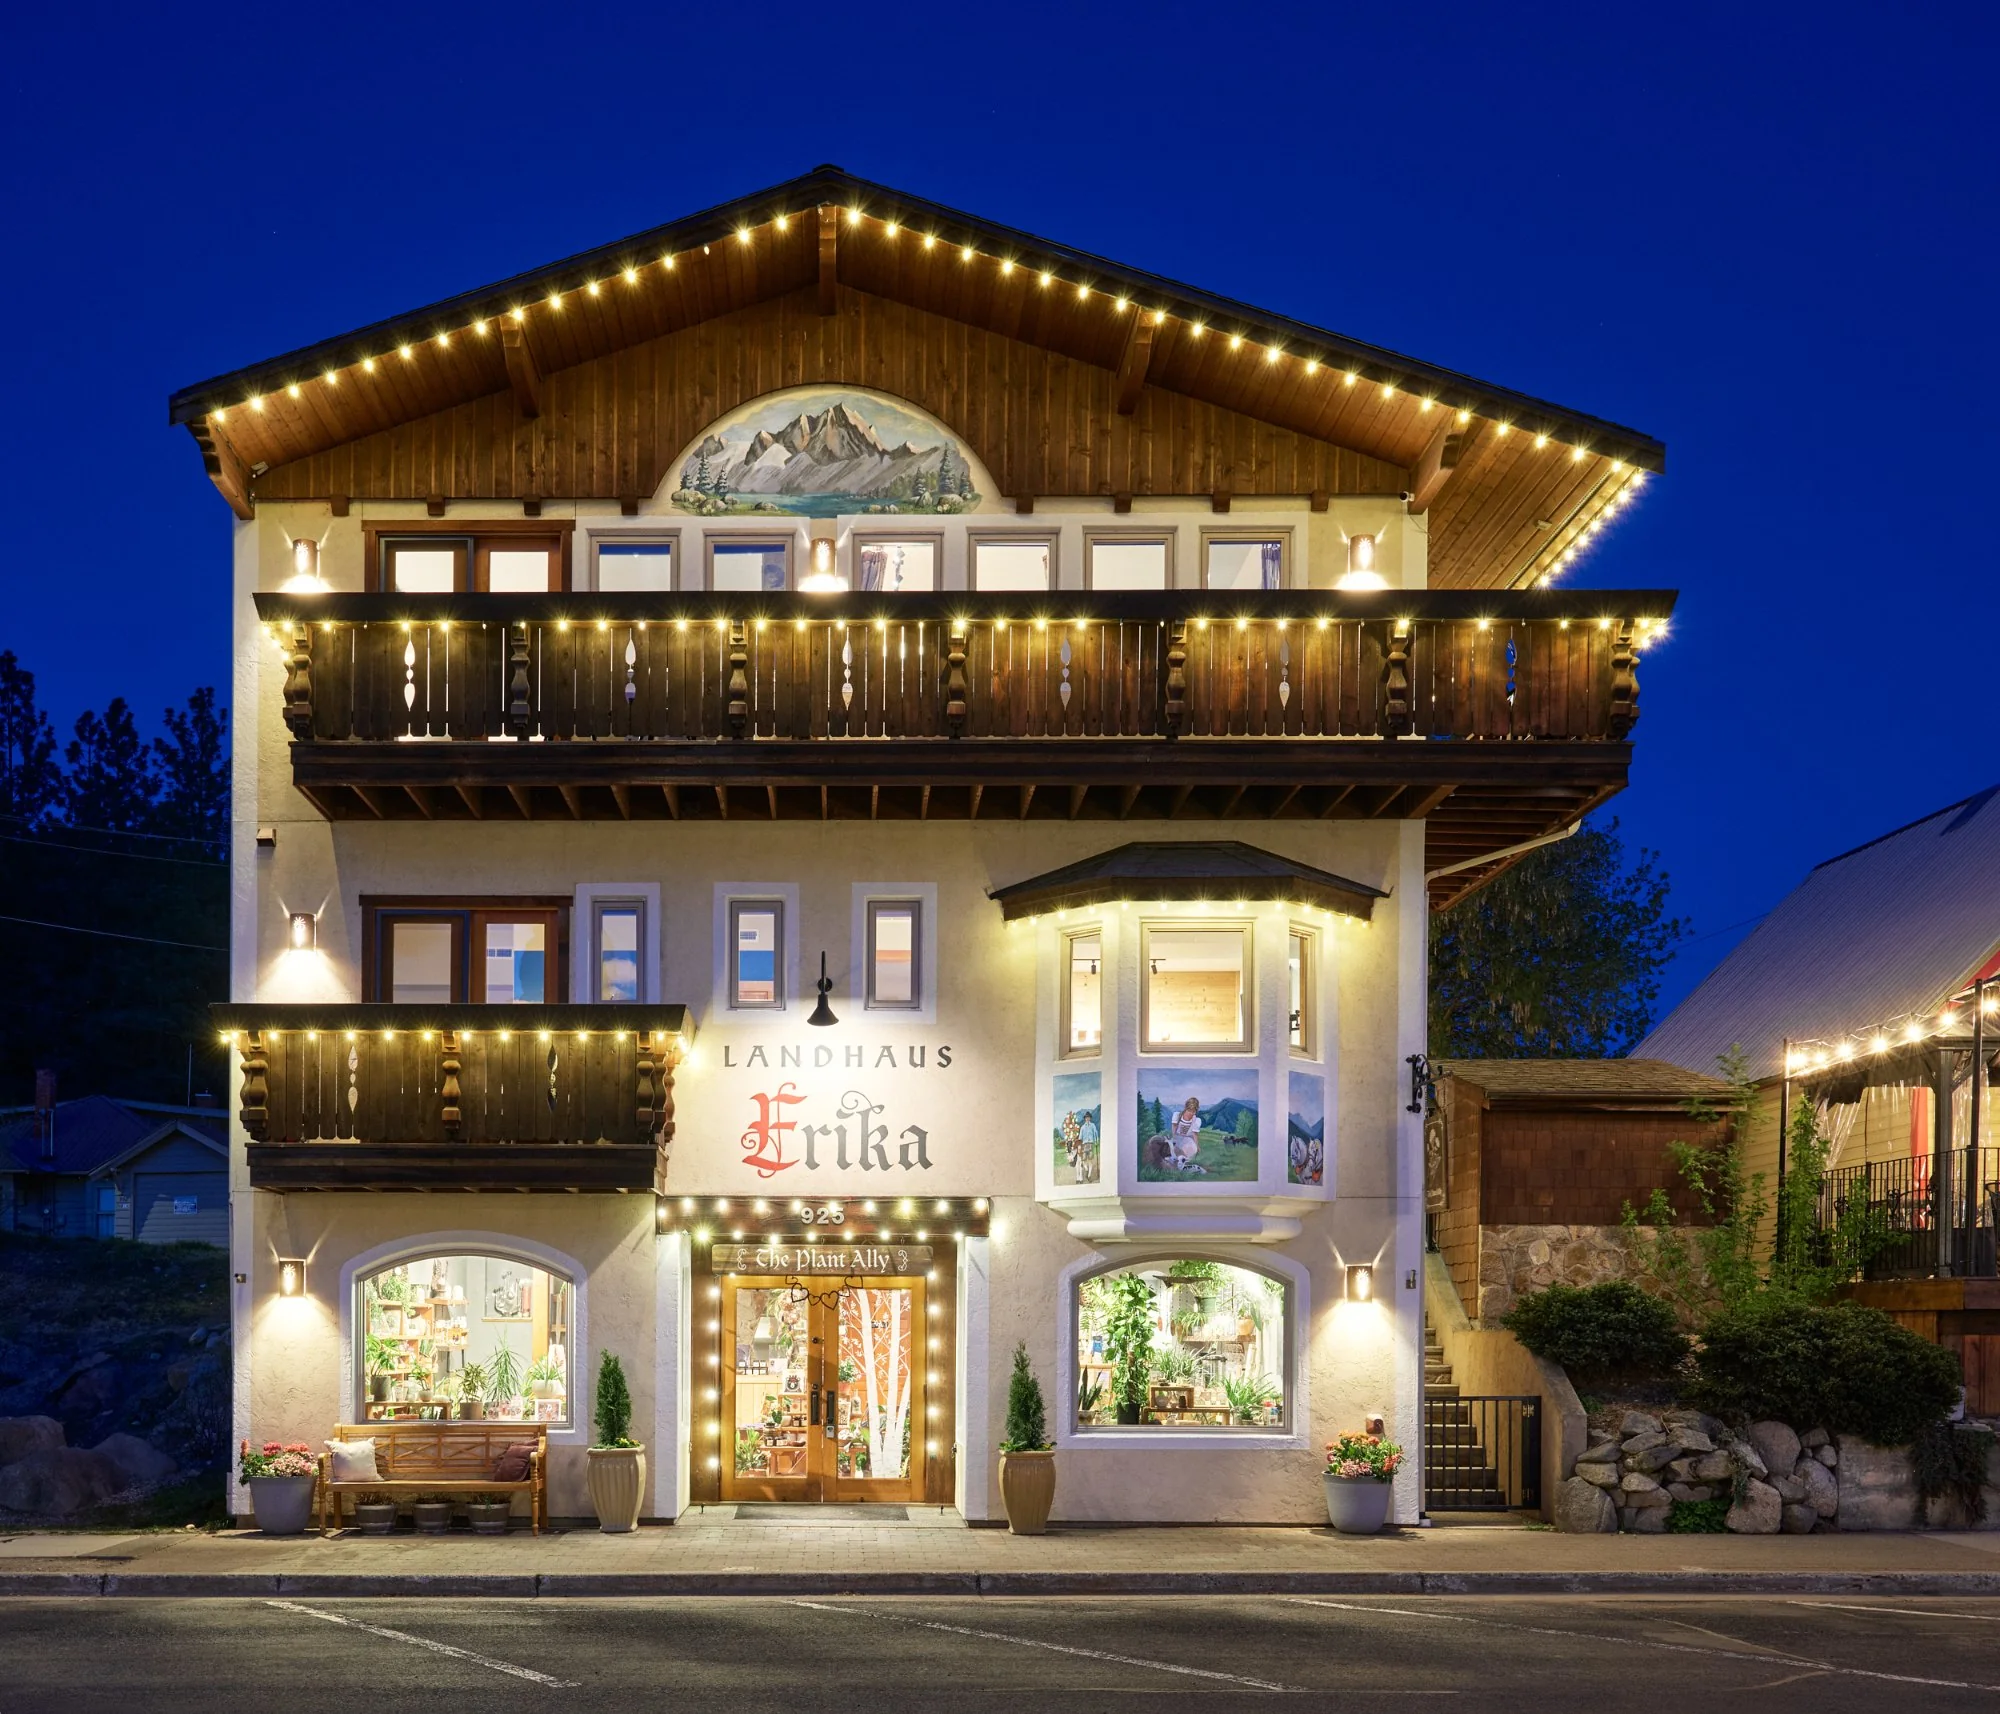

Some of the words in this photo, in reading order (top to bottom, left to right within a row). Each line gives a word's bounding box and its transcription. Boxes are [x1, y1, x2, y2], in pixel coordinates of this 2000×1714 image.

[724, 1045, 953, 1068] LANDHAUS
[741, 1082, 934, 1178] Erika
[801, 1207, 845, 1225] 925
[756, 1248, 790, 1270] The
[796, 1249, 847, 1271] Plant
[850, 1249, 890, 1272] Ally
